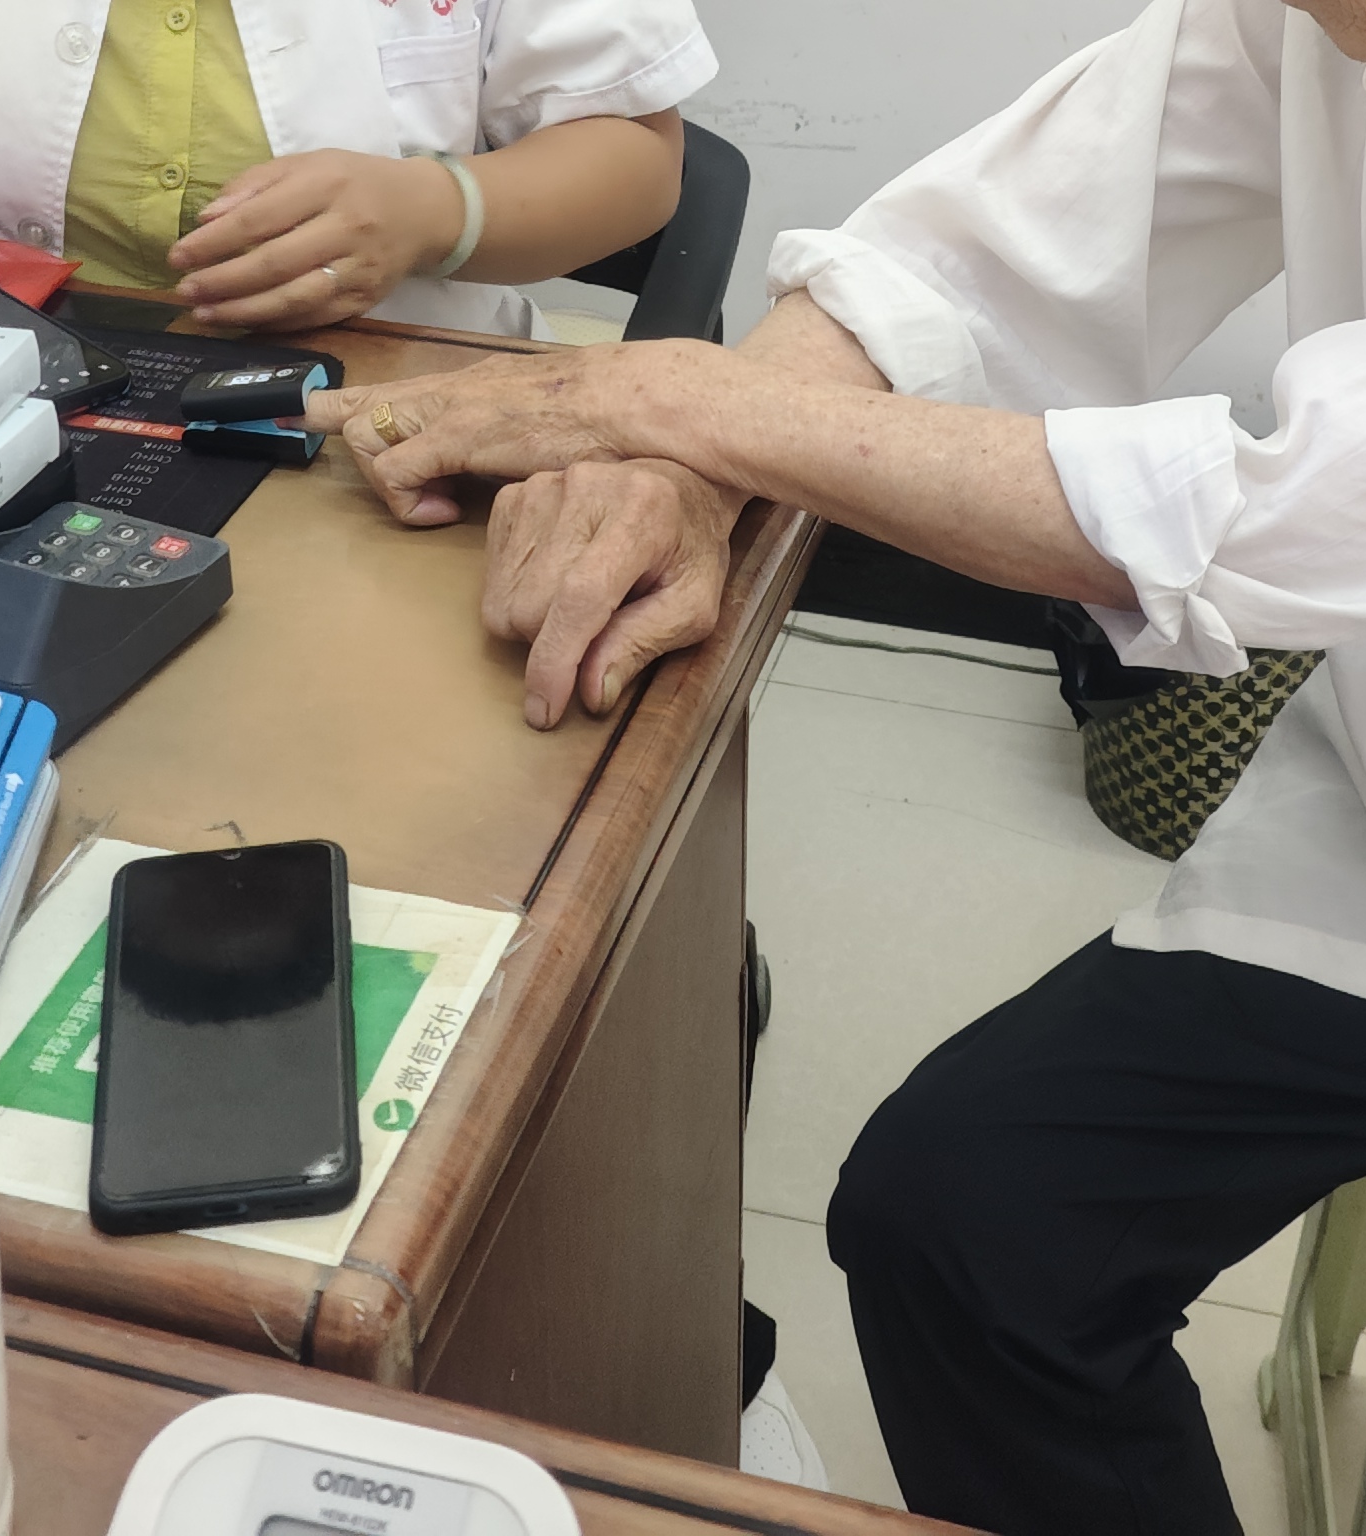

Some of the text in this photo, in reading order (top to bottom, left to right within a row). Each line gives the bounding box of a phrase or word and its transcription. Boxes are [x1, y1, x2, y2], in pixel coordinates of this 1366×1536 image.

[140, 441, 182, 454] Ctrl+K
[129, 451, 173, 465] Ctrl+U
[122, 462, 160, 475] Ctrl+I
[111, 472, 153, 486] Ctrl+B
[101, 483, 142, 497] Ctrl+E
[90, 494, 133, 508] Ctrl+P
[120, 528, 135, 539] 0
[96, 547, 111, 558] 8
[138, 559, 154, 570] 7
[70, 566, 87, 578] 5
[394, 1002, 465, 1093] 微信支付
[312, 1468, 417, 1512] OMRON
